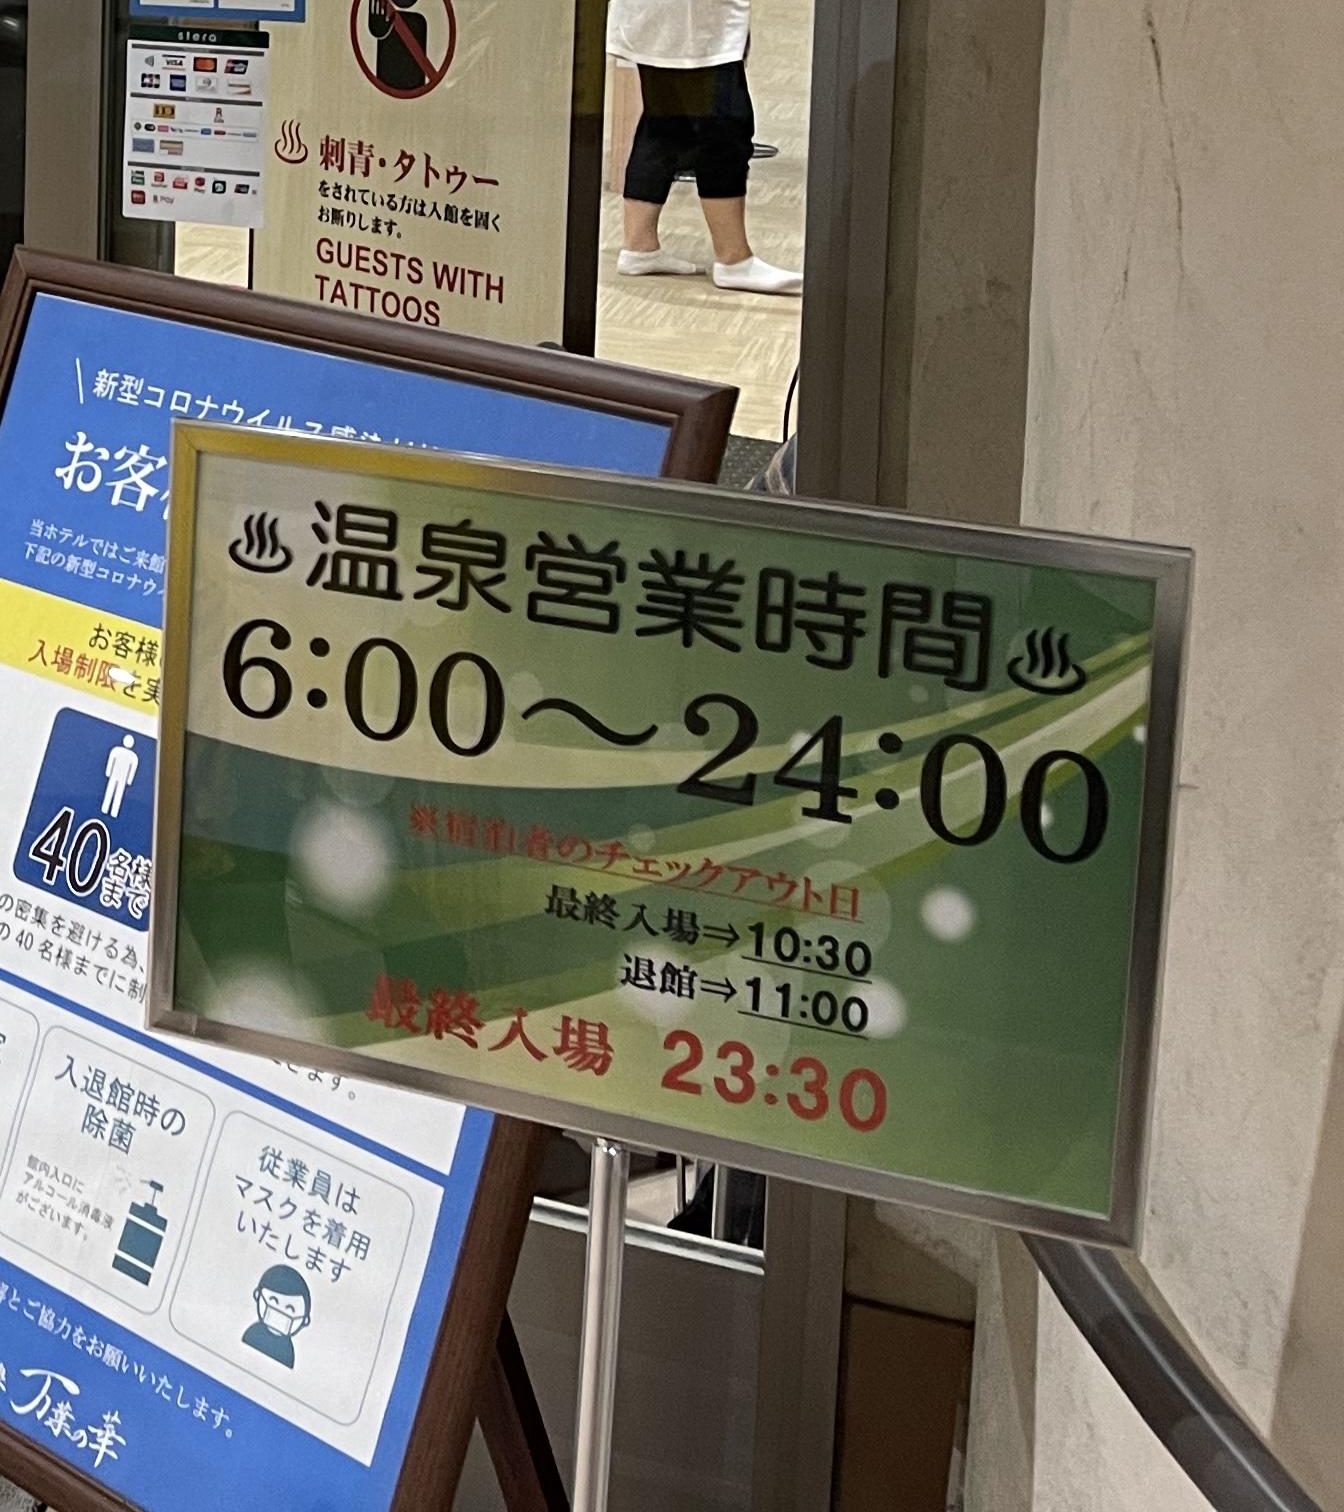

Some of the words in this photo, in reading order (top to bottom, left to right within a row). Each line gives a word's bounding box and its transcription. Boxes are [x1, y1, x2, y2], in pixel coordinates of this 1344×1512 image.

[178, 31, 217, 42] stera
[320, 134, 499, 194] 刺青・タトゥー
[317, 206, 403, 240] お断りします。
[315, 274, 441, 327] TATTOOS
[316, 237, 423, 284] GUESTS
[433, 261, 504, 304] WITH
[55, 431, 171, 520] お客
[24, 541, 164, 596] 下記の新型コロナウ
[305, 498, 994, 690] 温泉営業時間
[88, 623, 162, 667] お客様
[29, 806, 111, 896] 40
[746, 918, 873, 978] 10:30
[744, 979, 870, 1034] 11:00
[366, 973, 616, 1080] 最終入場
[660, 1029, 890, 1134] 23:30
[54, 1055, 187, 1137] 入退館時の
[80, 1104, 137, 1155] 除菌
[258, 1144, 361, 1216] 従業員は
[234, 1175, 372, 1262] マスクを着用
[237, 1210, 352, 1284] いたします
